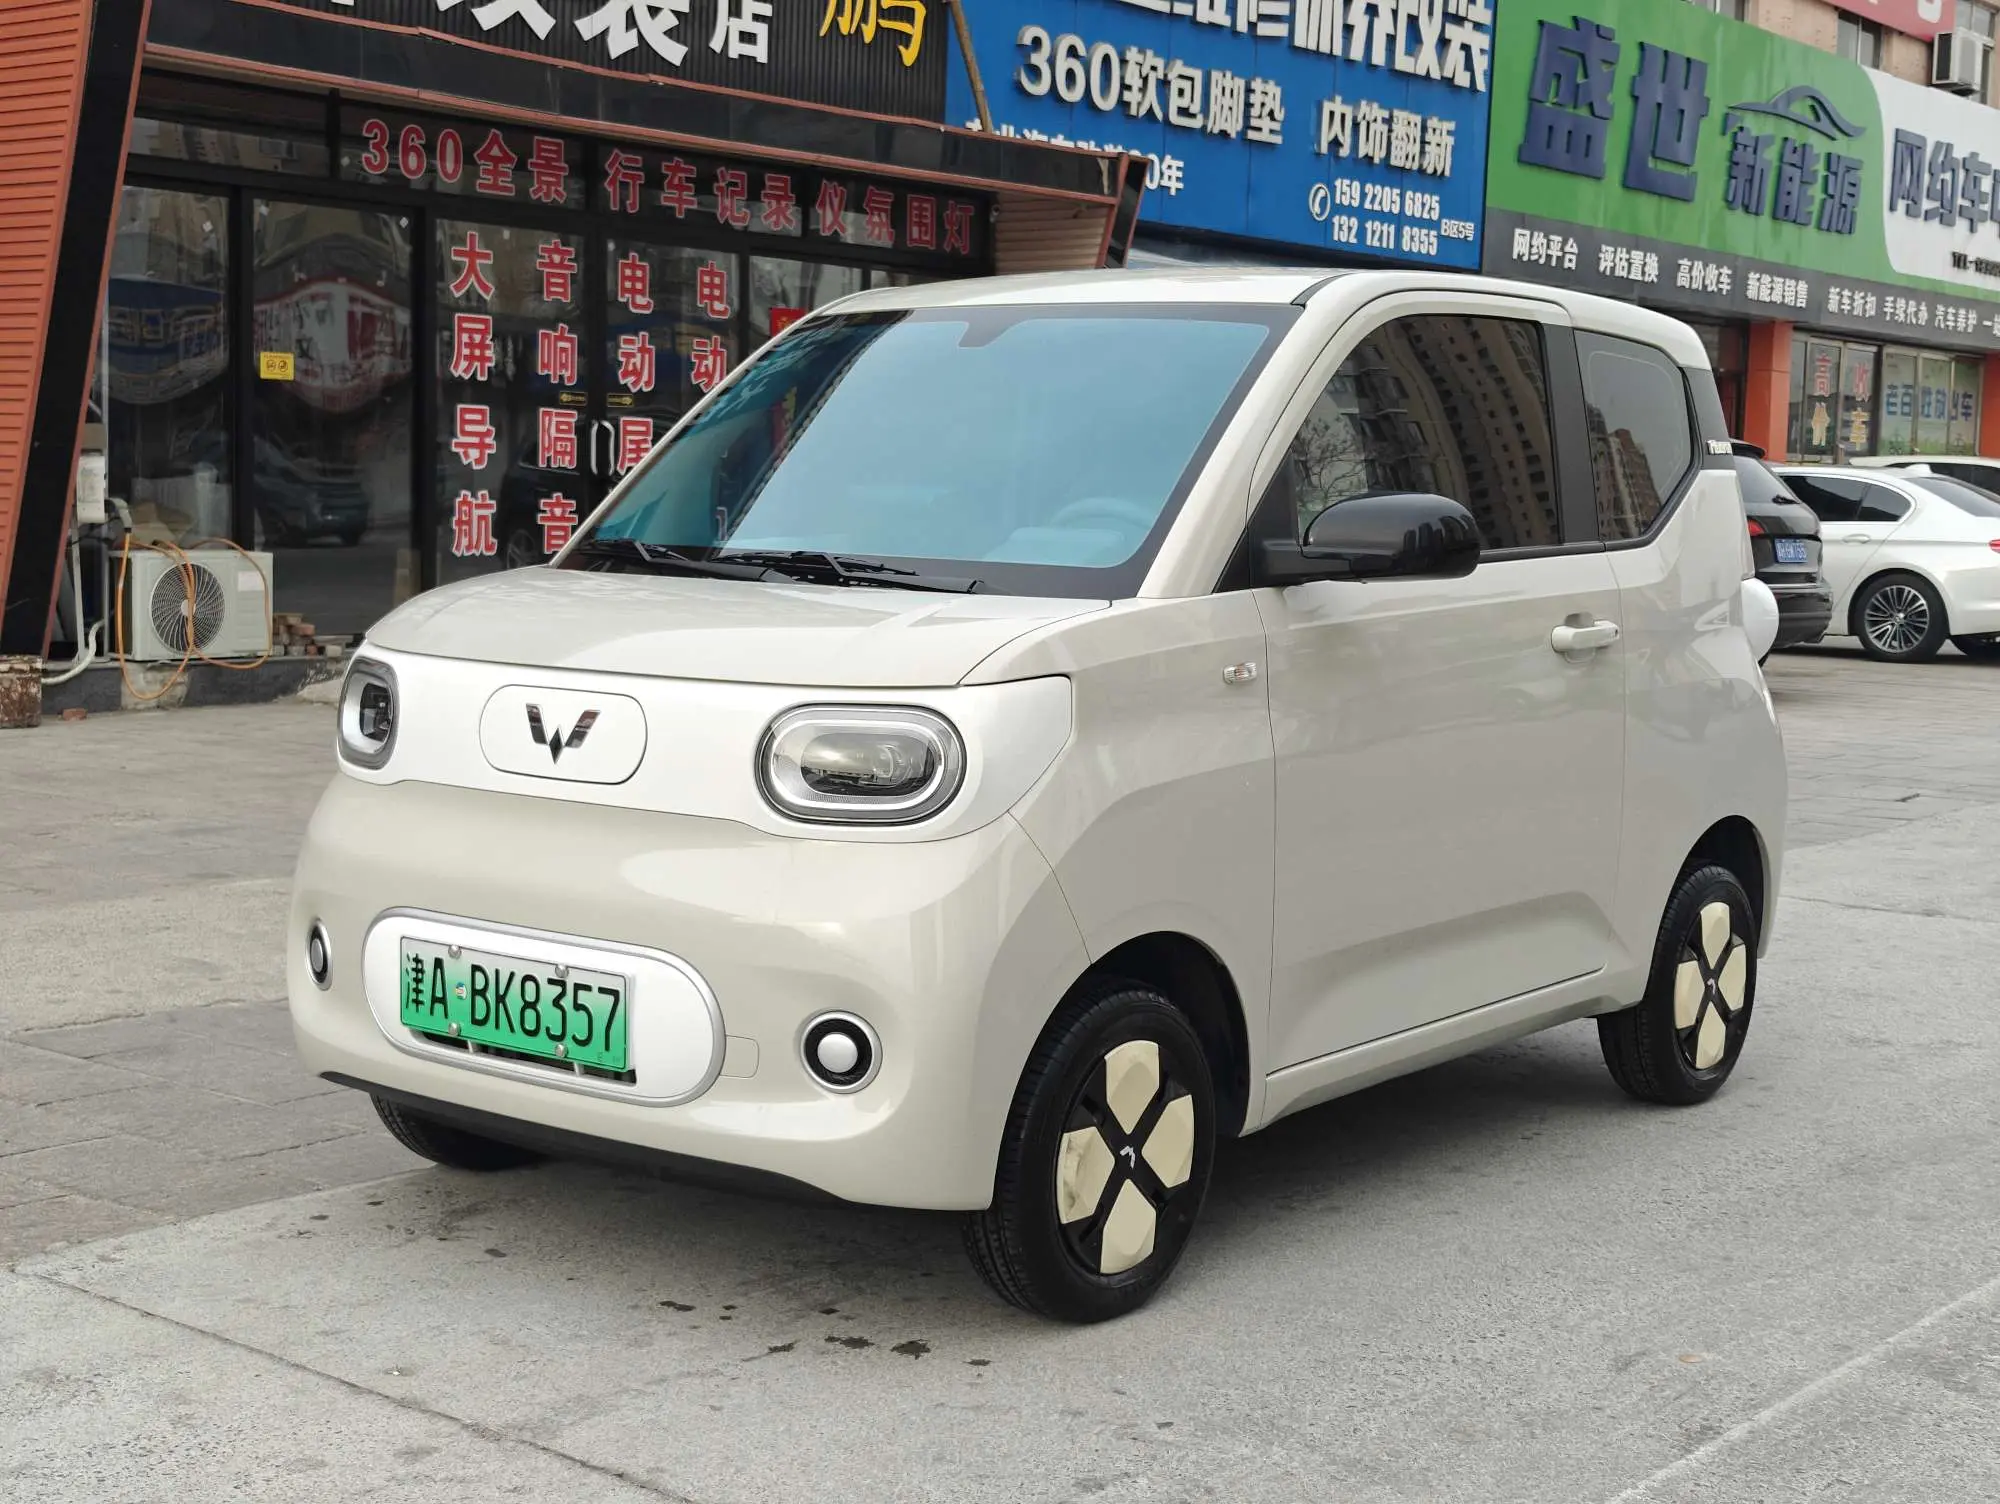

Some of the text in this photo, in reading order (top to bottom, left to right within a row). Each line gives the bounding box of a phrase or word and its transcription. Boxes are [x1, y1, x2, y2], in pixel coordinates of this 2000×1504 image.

[1015, 25, 1285, 144] 360软包脚垫
[1518, 15, 1863, 235] 盛世 新能源
[361, 118, 569, 203] 360全景
[1319, 94, 1456, 177] 内饰翻新
[1332, 215, 1438, 256] 132 1211 8355
[1334, 178, 1440, 221] 159 2205 6825
[1440, 218, 1475, 241] B区5号
[1512, 228, 1579, 271] 网约平台
[1598, 244, 1660, 284] 评估置换
[1676, 257, 1732, 296] 高价收车
[1746, 272, 1809, 309] 新能源销售
[1827, 286, 1877, 318] 新车折扣
[1934, 304, 1977, 333] 汽车养护
[450, 231, 497, 557] 大屏导航
